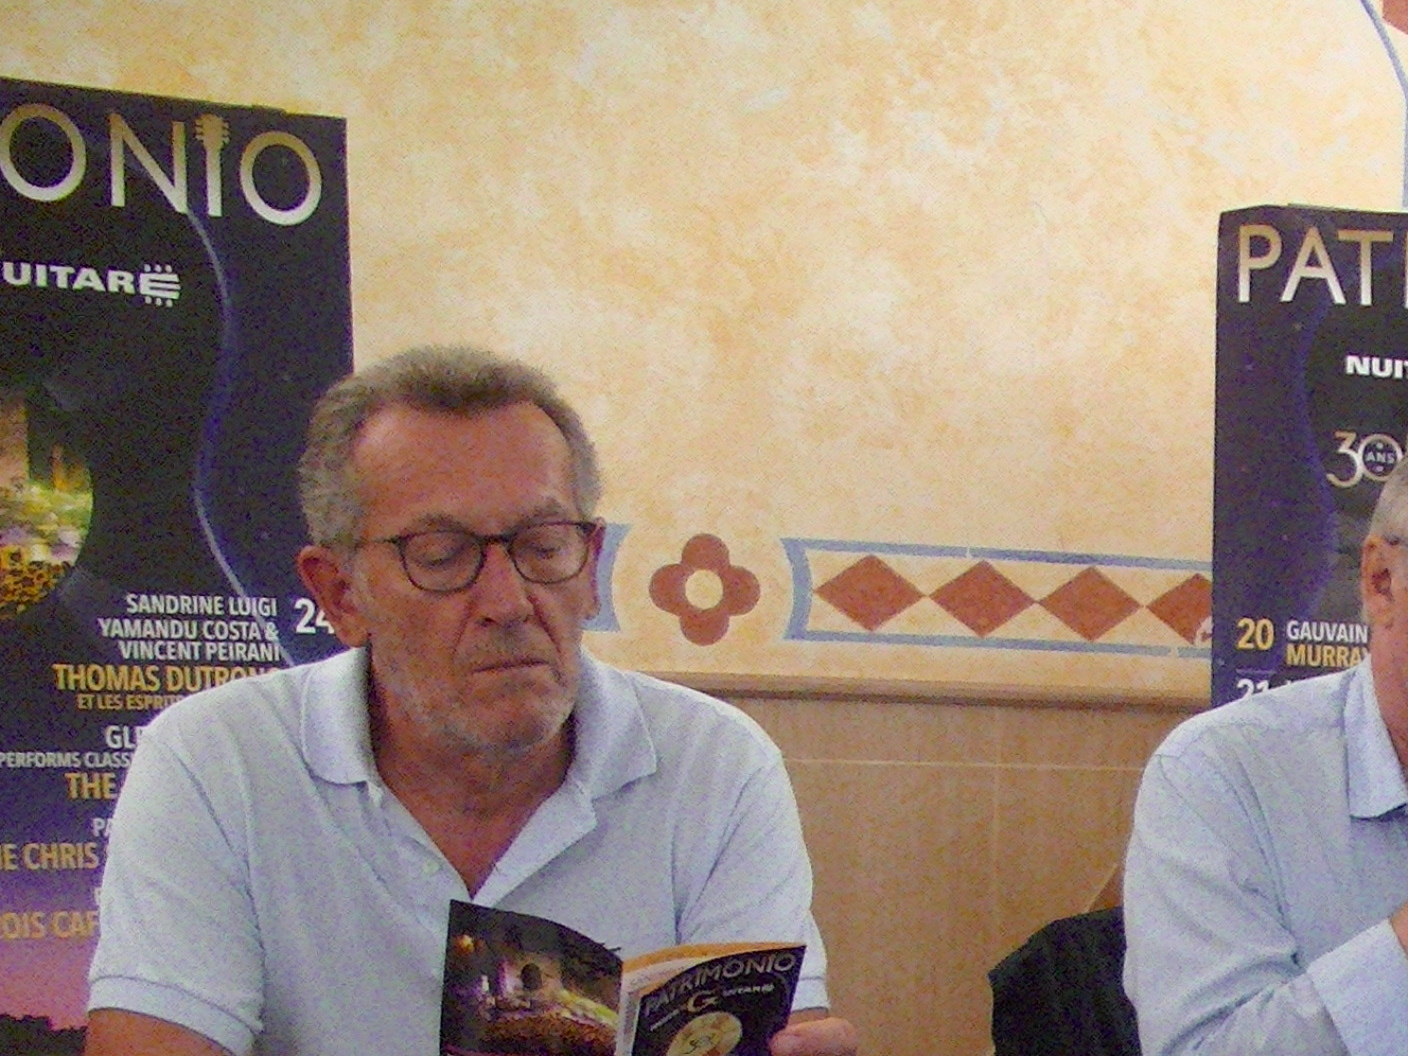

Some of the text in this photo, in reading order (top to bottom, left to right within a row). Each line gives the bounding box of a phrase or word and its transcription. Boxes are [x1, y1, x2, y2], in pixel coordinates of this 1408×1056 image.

[1326, 430, 1403, 488] 30
[1365, 450, 1396, 464] ANS
[126, 594, 278, 617] SANDRINE LUIGI
[294, 598, 335, 635] 24
[98, 618, 280, 642] YAMANDU COSTA &
[1236, 618, 1274, 650] 20
[1286, 620, 1369, 643] GAUVAIN
[119, 640, 281, 663] VINCENT PEIRANI
[52, 663, 161, 692] THOMAS
[77, 694, 95, 709] ET
[98, 694, 124, 710] LES
[0, 752, 82, 768] PERFORMS
[65, 772, 116, 800] THE
[23, 843, 99, 869] CHRIS
